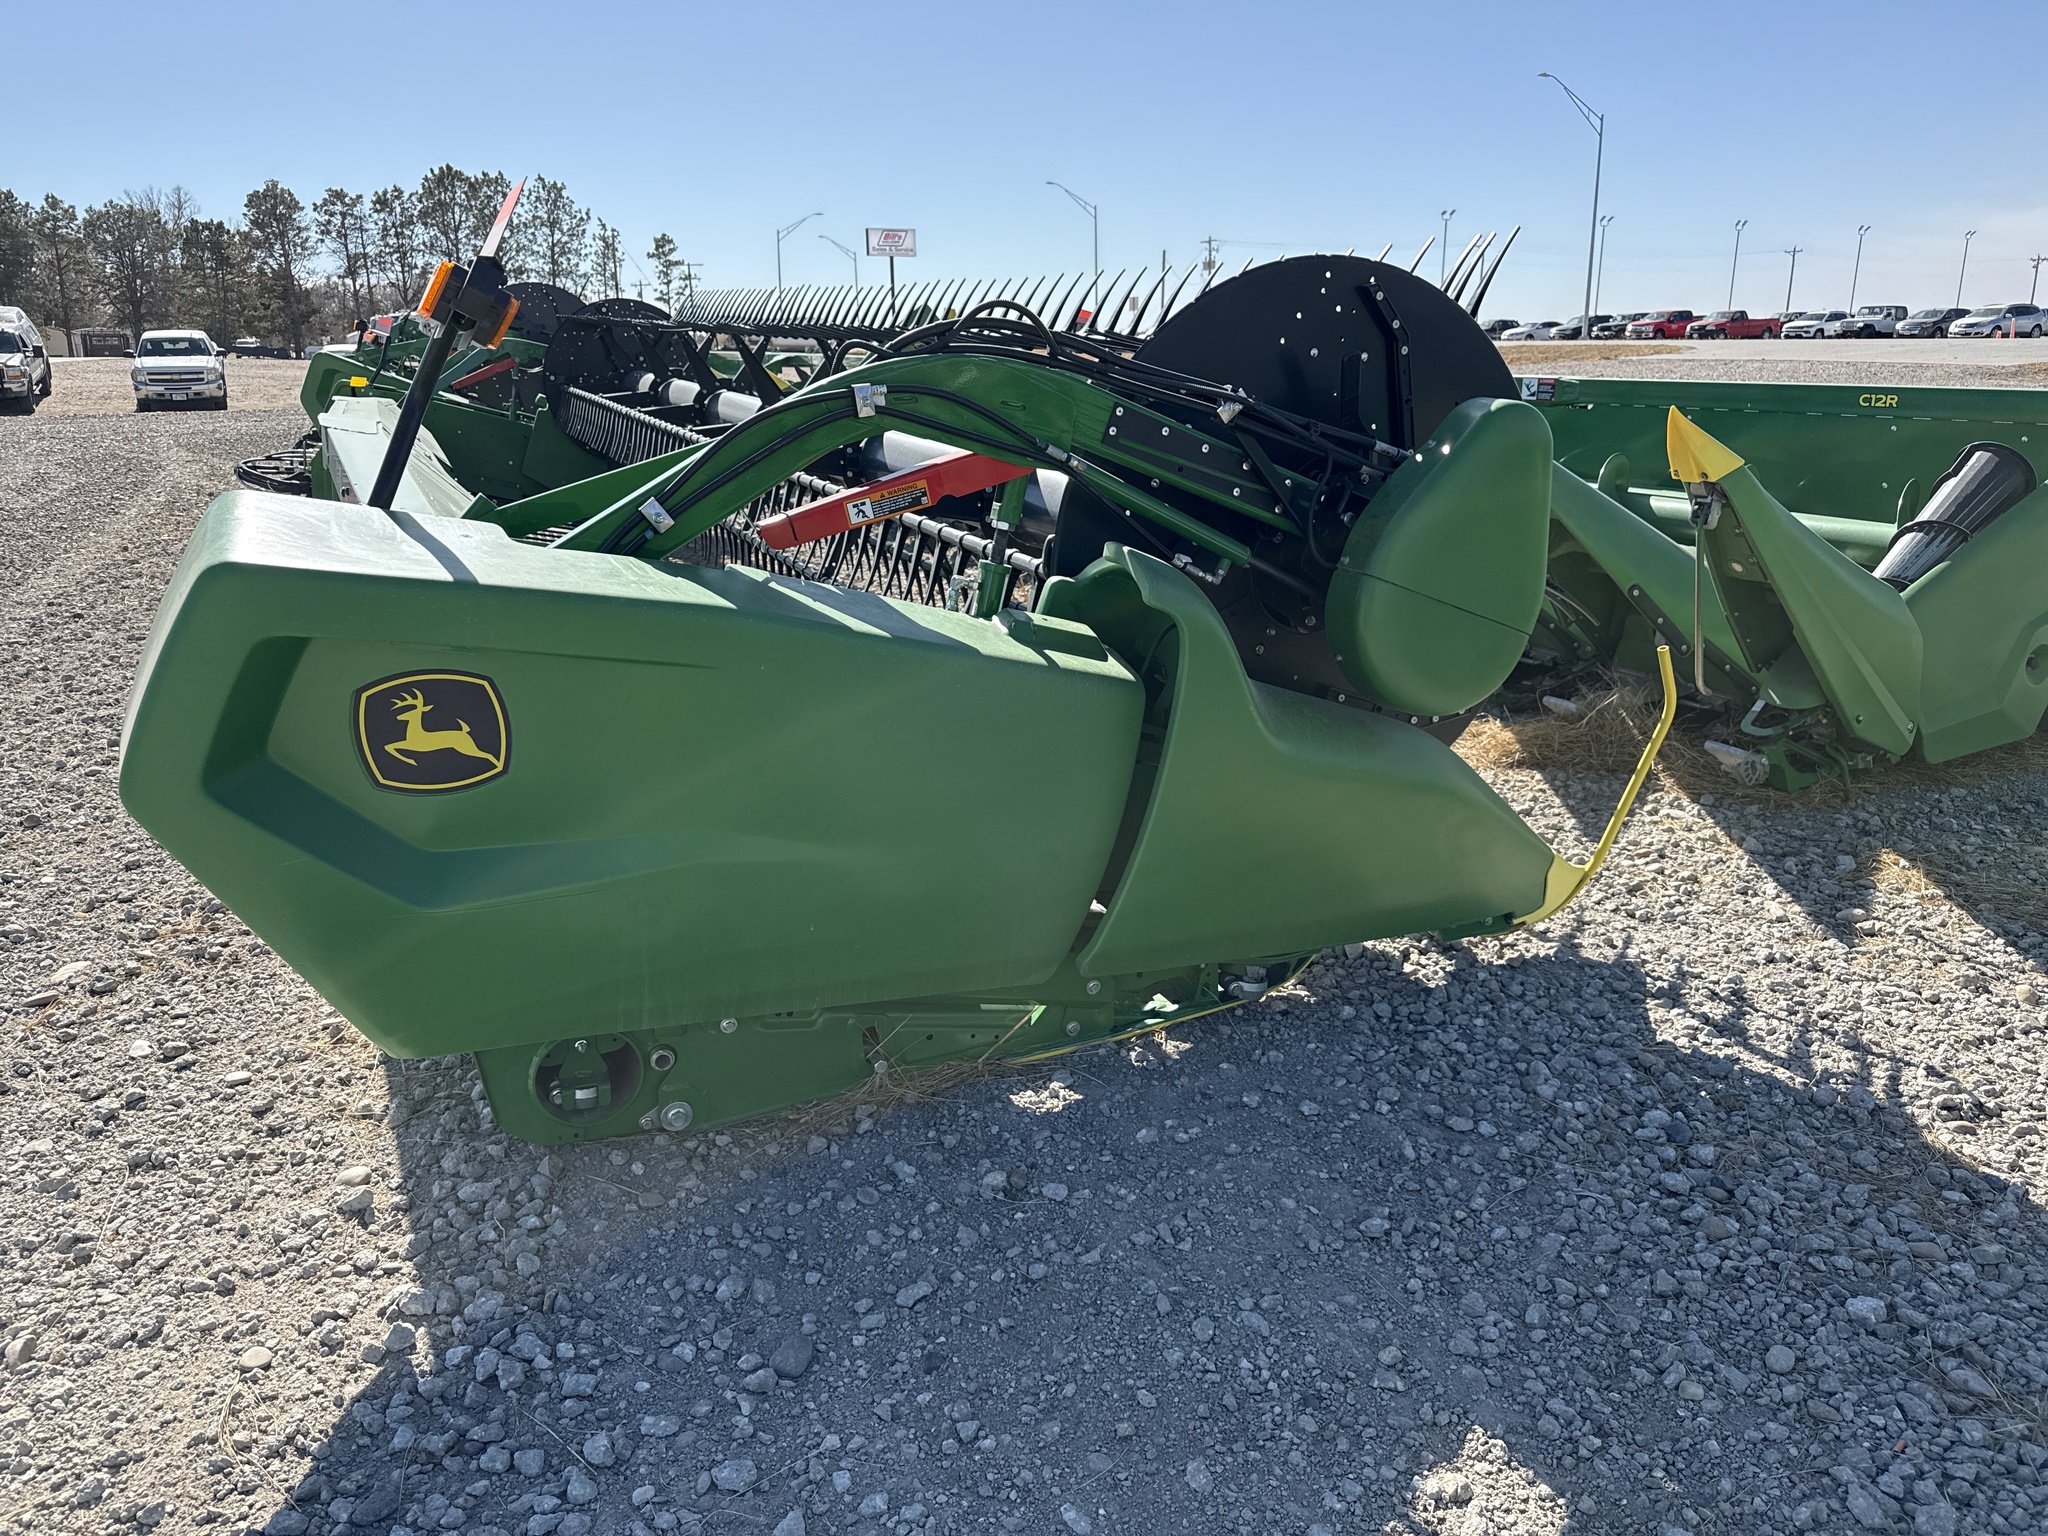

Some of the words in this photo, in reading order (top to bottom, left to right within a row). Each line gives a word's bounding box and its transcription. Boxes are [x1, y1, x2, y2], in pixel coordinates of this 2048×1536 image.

[883, 233, 902, 241] Bill's
[1858, 393, 1899, 407] C12R
[887, 483, 918, 496] WARNING
